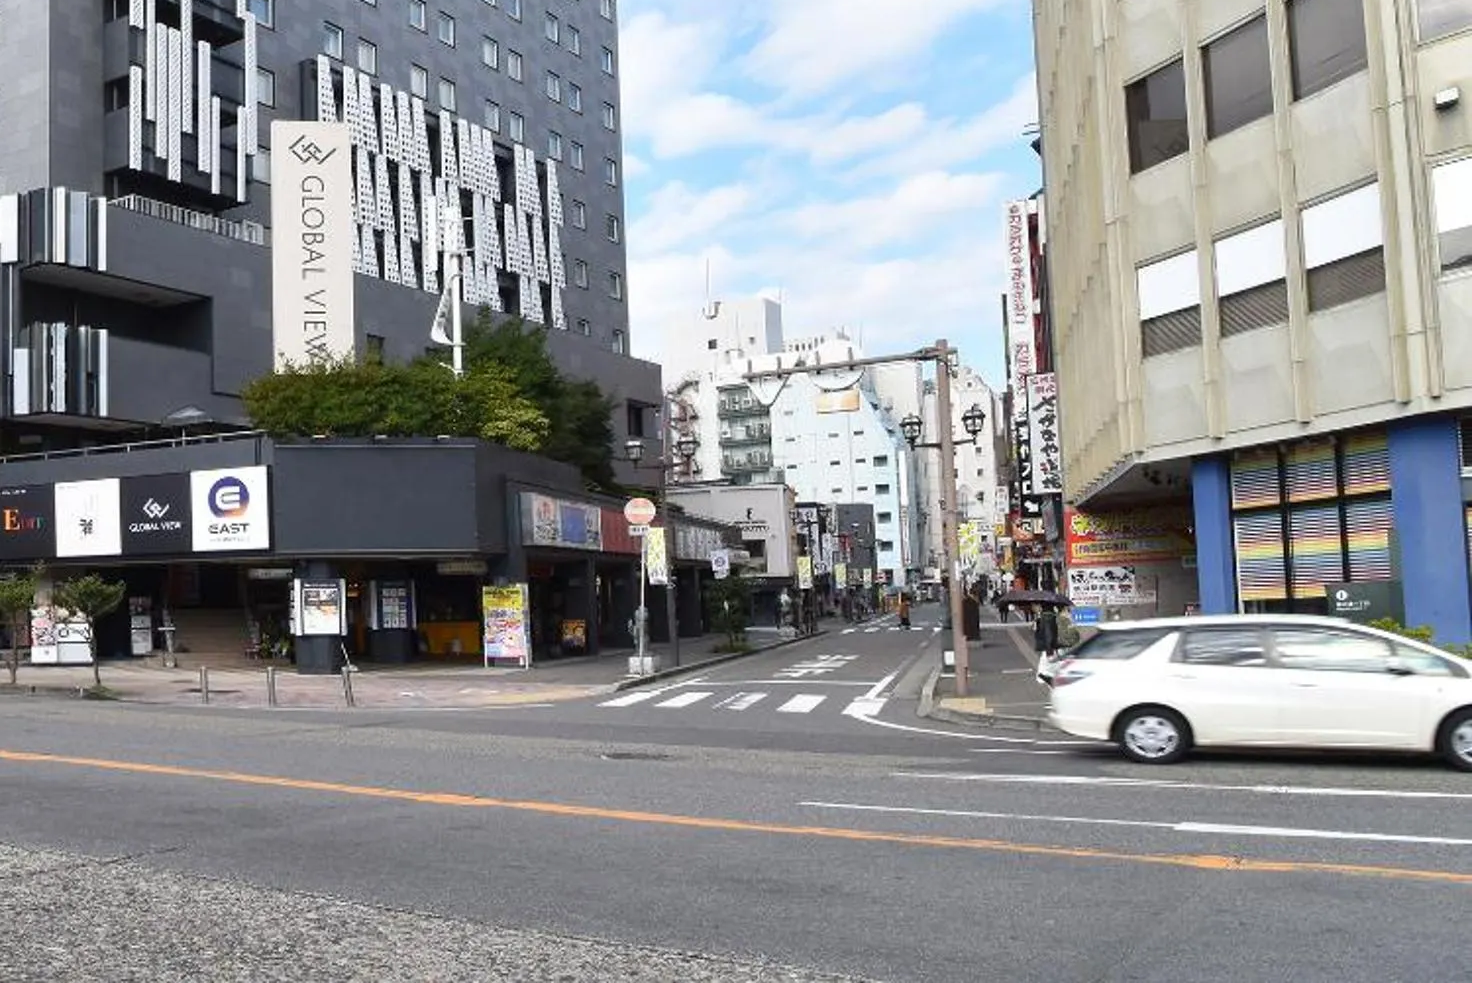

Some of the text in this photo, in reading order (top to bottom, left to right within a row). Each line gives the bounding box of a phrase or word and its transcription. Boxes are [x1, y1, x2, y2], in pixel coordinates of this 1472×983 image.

[301, 175, 326, 281] GLOBAL
[129, 522, 160, 533] GLOBAL
[208, 522, 251, 535] EAST
